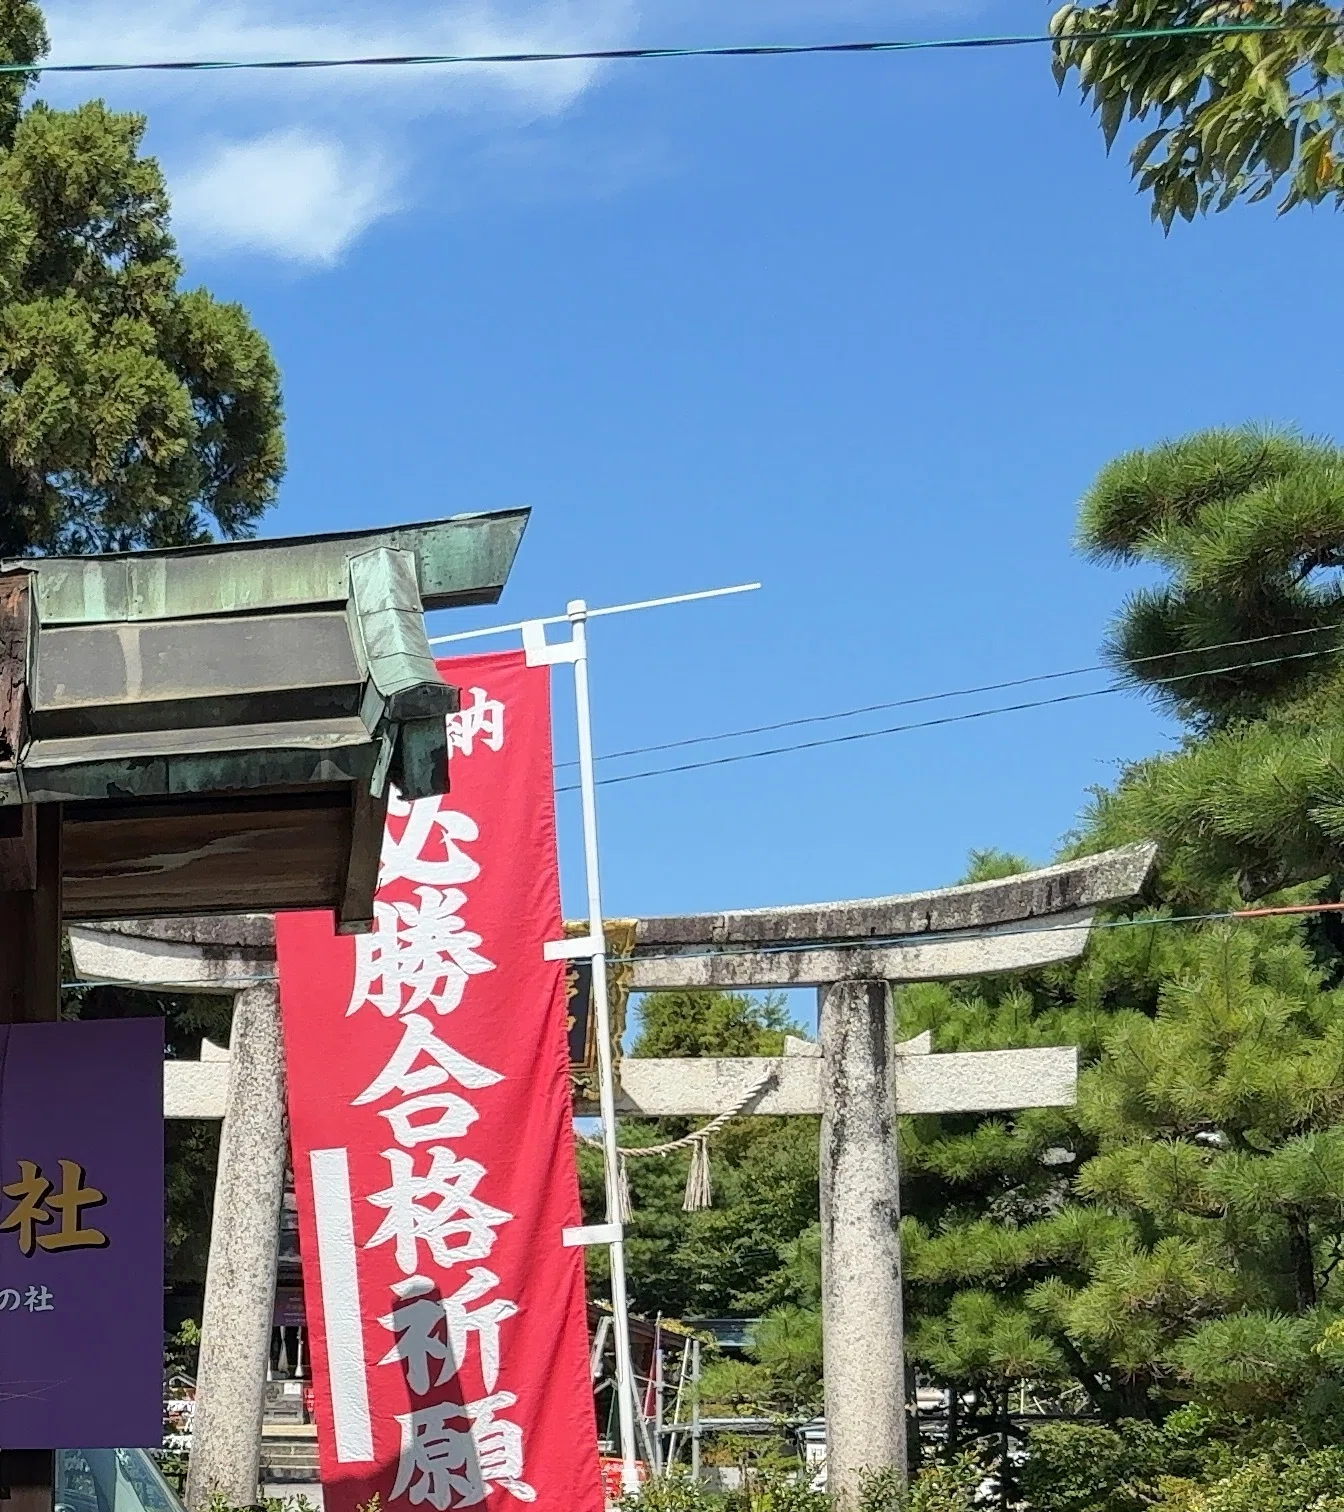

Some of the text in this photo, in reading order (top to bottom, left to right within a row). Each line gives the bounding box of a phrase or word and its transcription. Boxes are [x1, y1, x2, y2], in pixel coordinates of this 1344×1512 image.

[345, 783, 537, 1512] 必勝合格祈願
